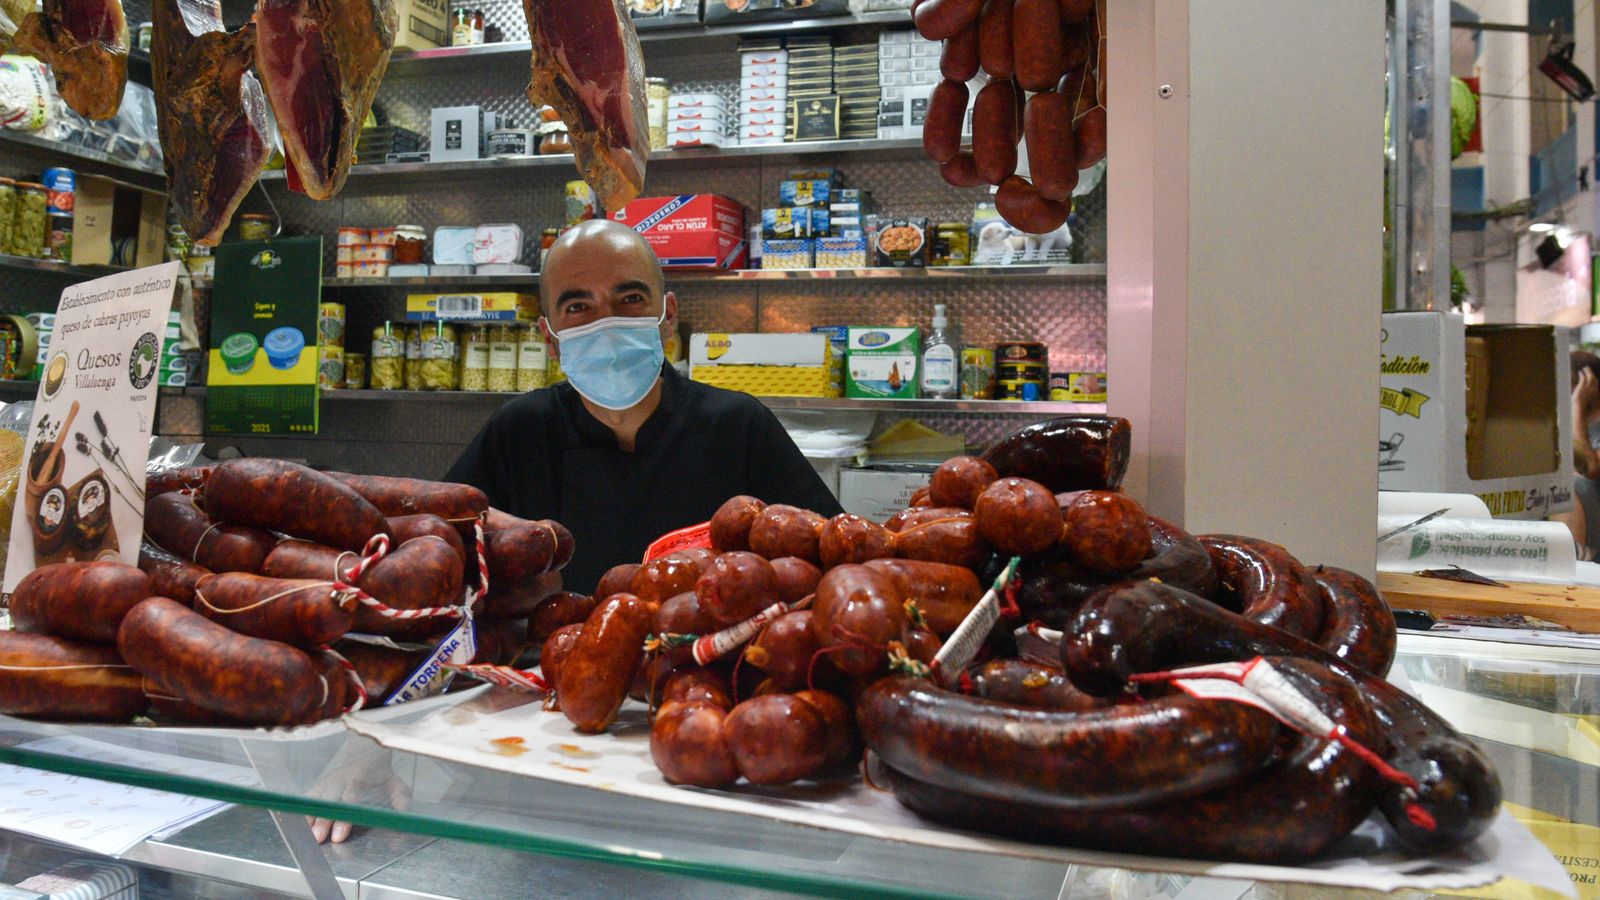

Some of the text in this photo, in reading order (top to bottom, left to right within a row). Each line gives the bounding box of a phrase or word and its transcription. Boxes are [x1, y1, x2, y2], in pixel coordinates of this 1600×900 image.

[635, 200, 681, 232] CONSORCIO
[657, 221, 707, 231] ATÚN CLARO
[61, 277, 171, 311] Establecimiento con auténtico
[61, 308, 151, 340] queso de cabras payoyas
[704, 340, 732, 348] ALBO
[77, 348, 122, 371] Quesos
[75, 374, 116, 391] Villaluenga
[251, 423, 270, 432] 2021
[1525, 534, 1546, 543] soy
[394, 689, 413, 705] LA
